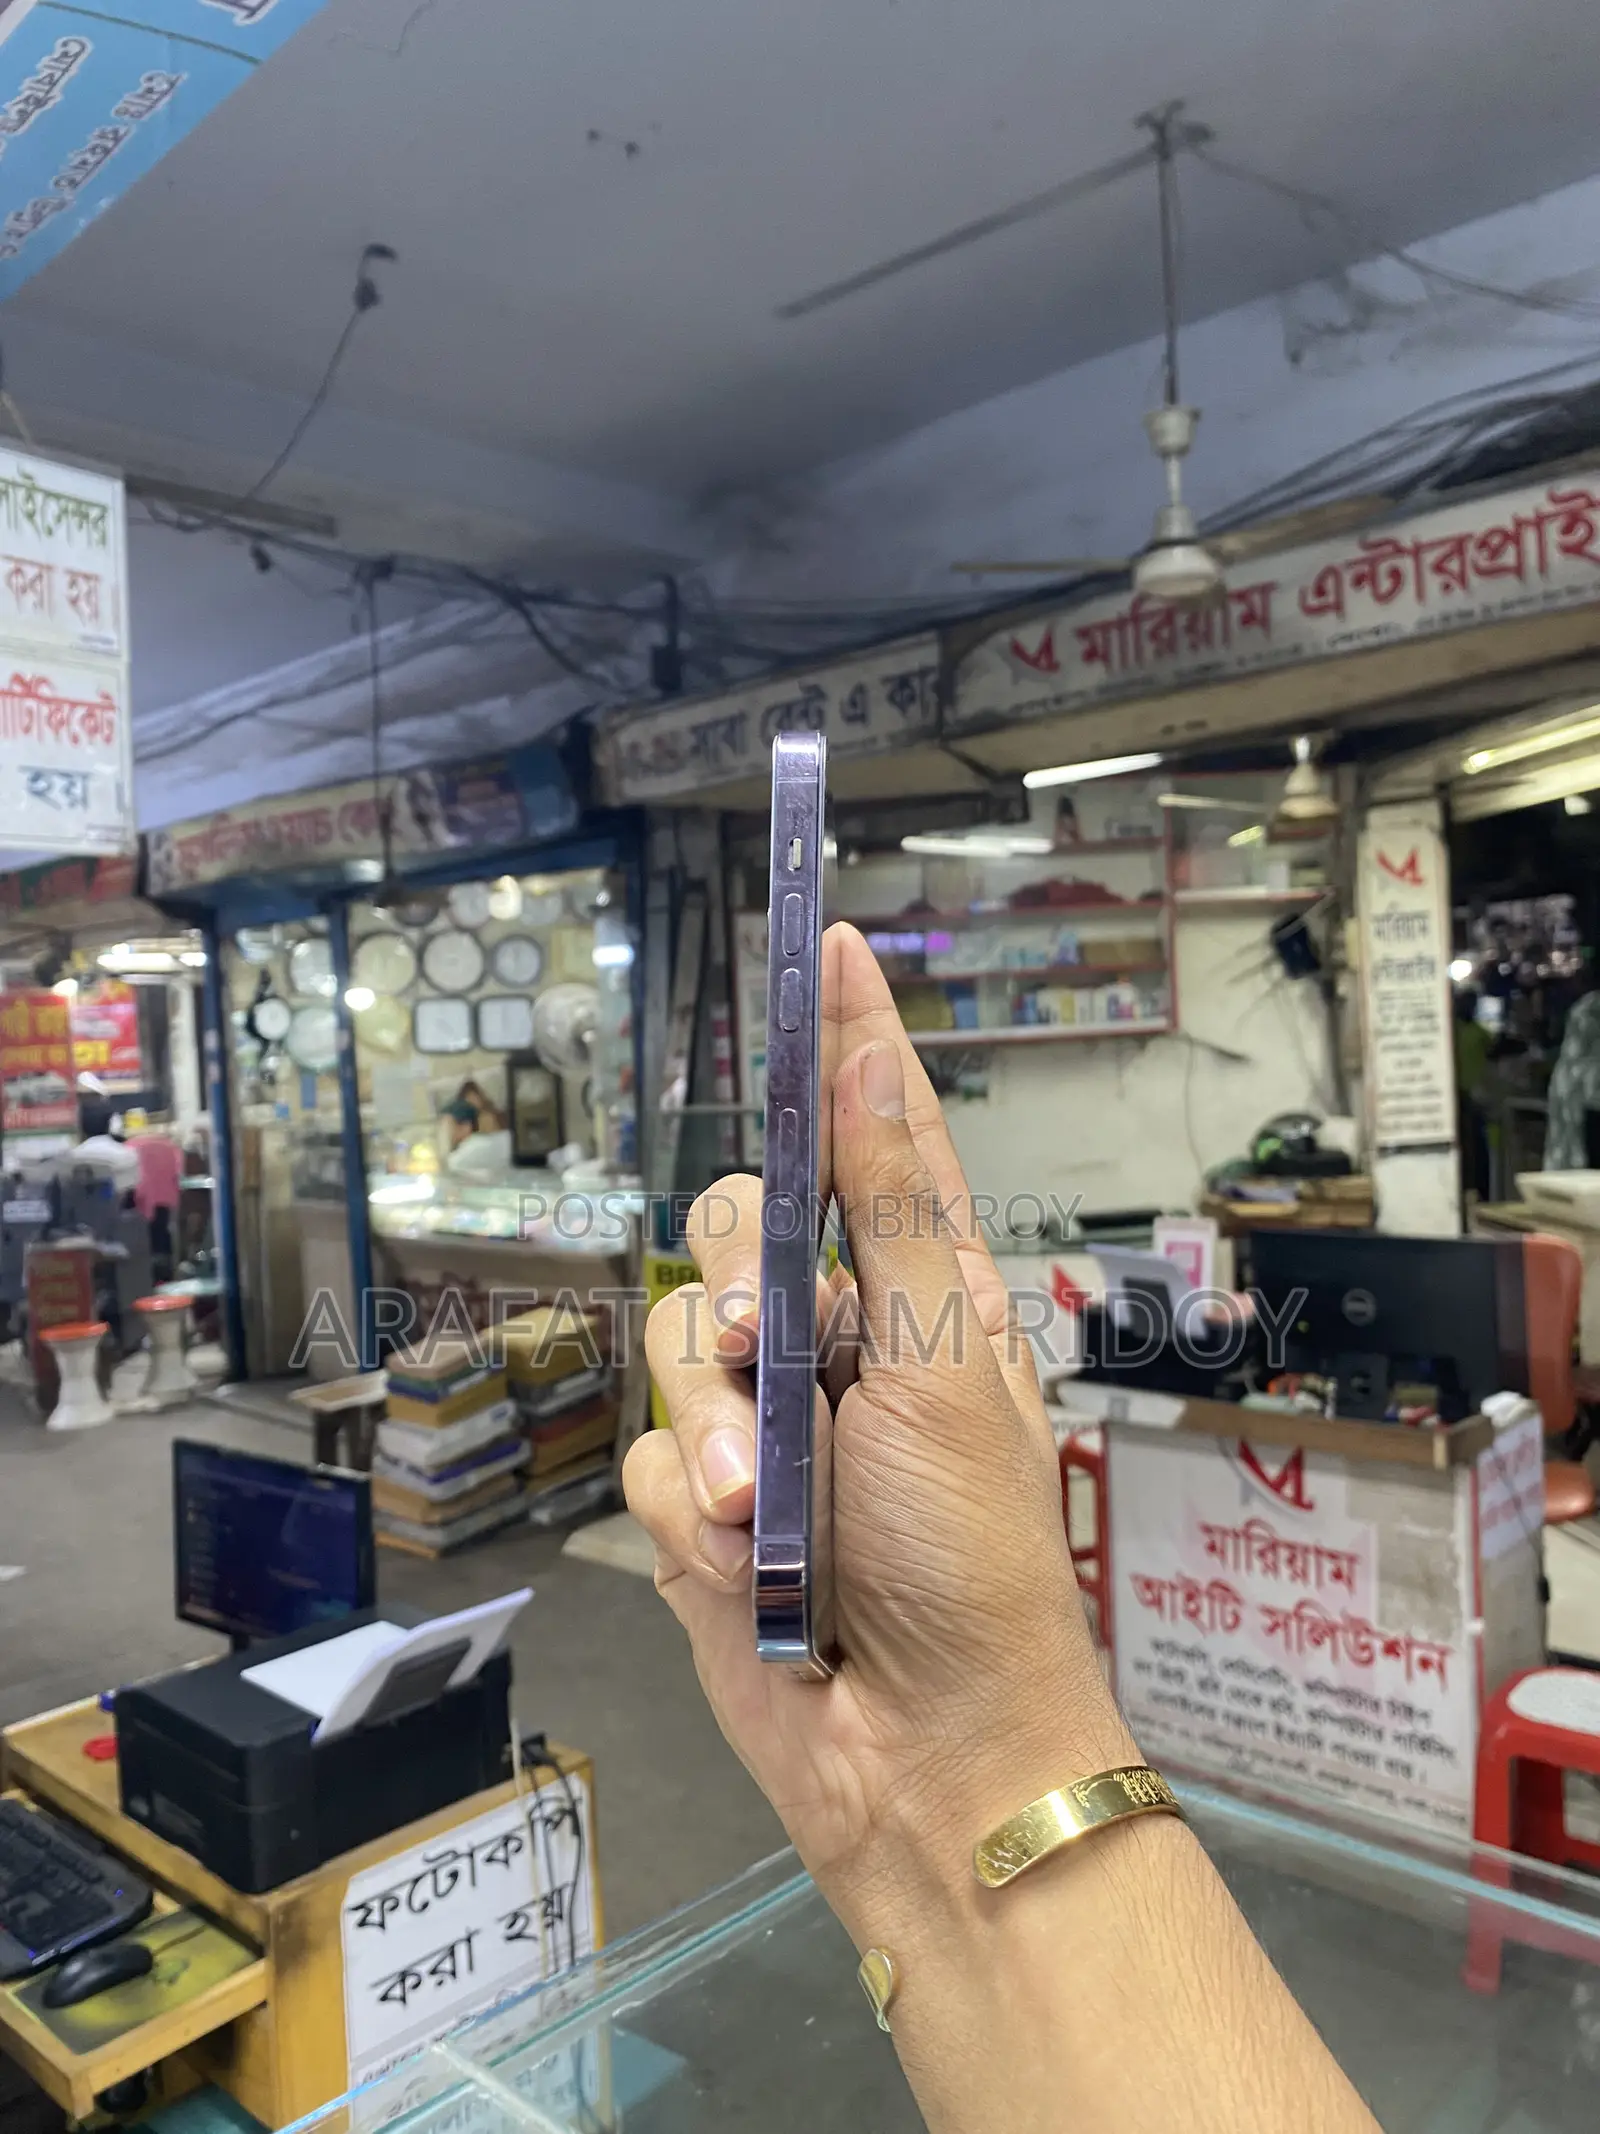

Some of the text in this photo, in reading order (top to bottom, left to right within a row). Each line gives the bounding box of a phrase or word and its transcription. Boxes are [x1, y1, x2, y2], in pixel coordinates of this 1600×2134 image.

[0, 555, 55, 621] করা
[64, 568, 102, 628] হয়
[1075, 581, 1280, 676] মারিয়াম
[0, 671, 117, 746] ার্টিফিকেট
[18, 765, 93, 811] হয়
[1199, 1518, 1360, 1596] মারিয়াম
[1128, 1571, 1457, 1693] আইটি সলিউশন
[370, 1928, 482, 2007] করা
